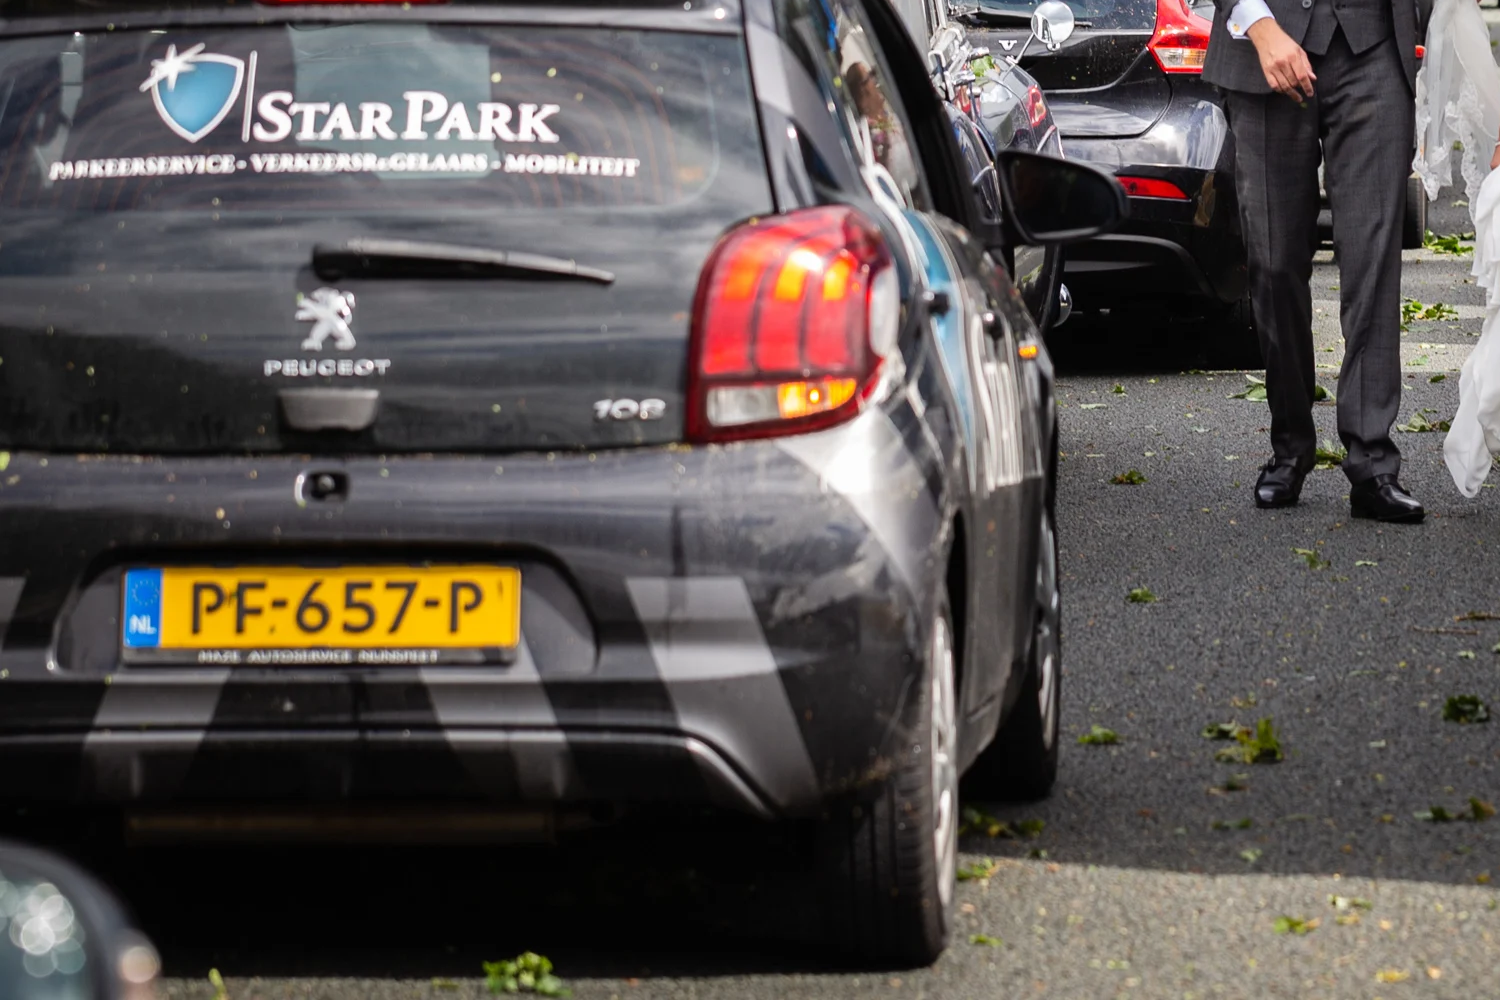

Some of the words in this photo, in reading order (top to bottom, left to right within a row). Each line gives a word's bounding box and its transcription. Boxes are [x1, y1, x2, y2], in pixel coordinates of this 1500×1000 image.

[49, 154, 236, 180] PARKEERSERVICE
[503, 153, 640, 177] MOBILITEIT
[263, 358, 391, 377] PEUGEOT
[593, 398, 666, 420] 108
[129, 615, 157, 634] NL
[191, 580, 484, 635] PF-657-P
